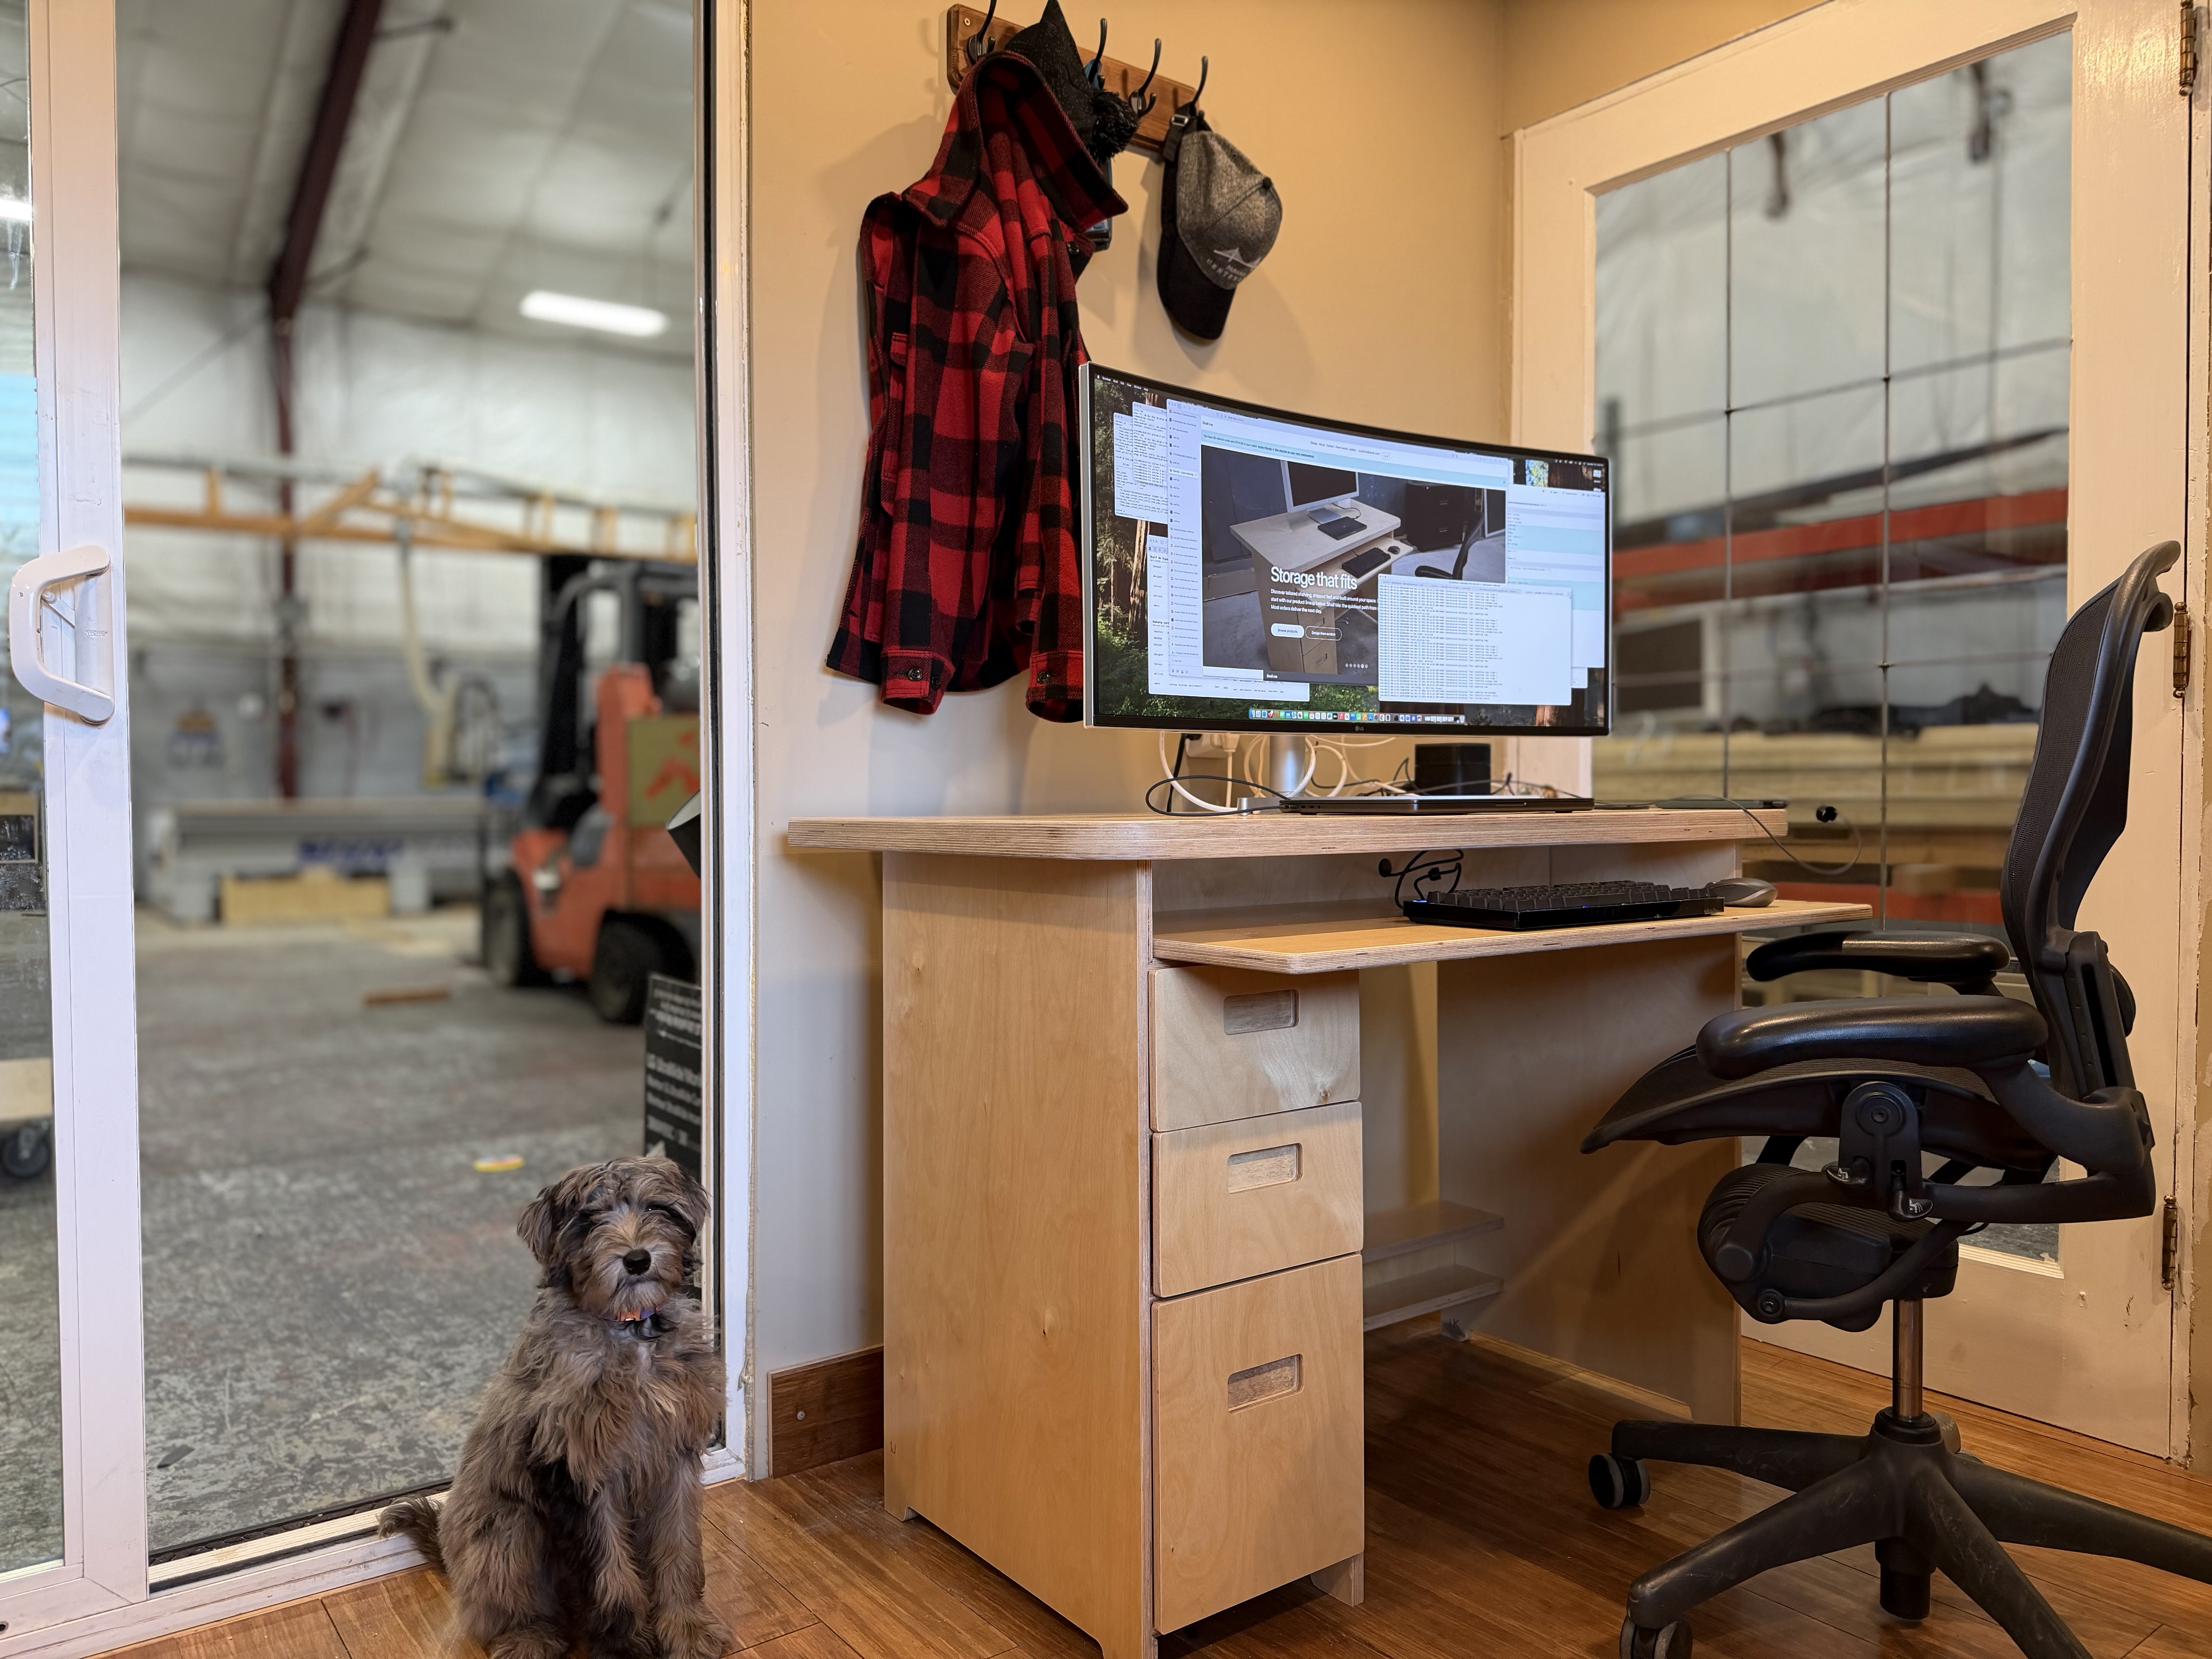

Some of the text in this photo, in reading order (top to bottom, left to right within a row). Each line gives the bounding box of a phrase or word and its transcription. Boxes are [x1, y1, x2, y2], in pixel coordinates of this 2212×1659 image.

[1271, 566, 1357, 589] Storage that fits
